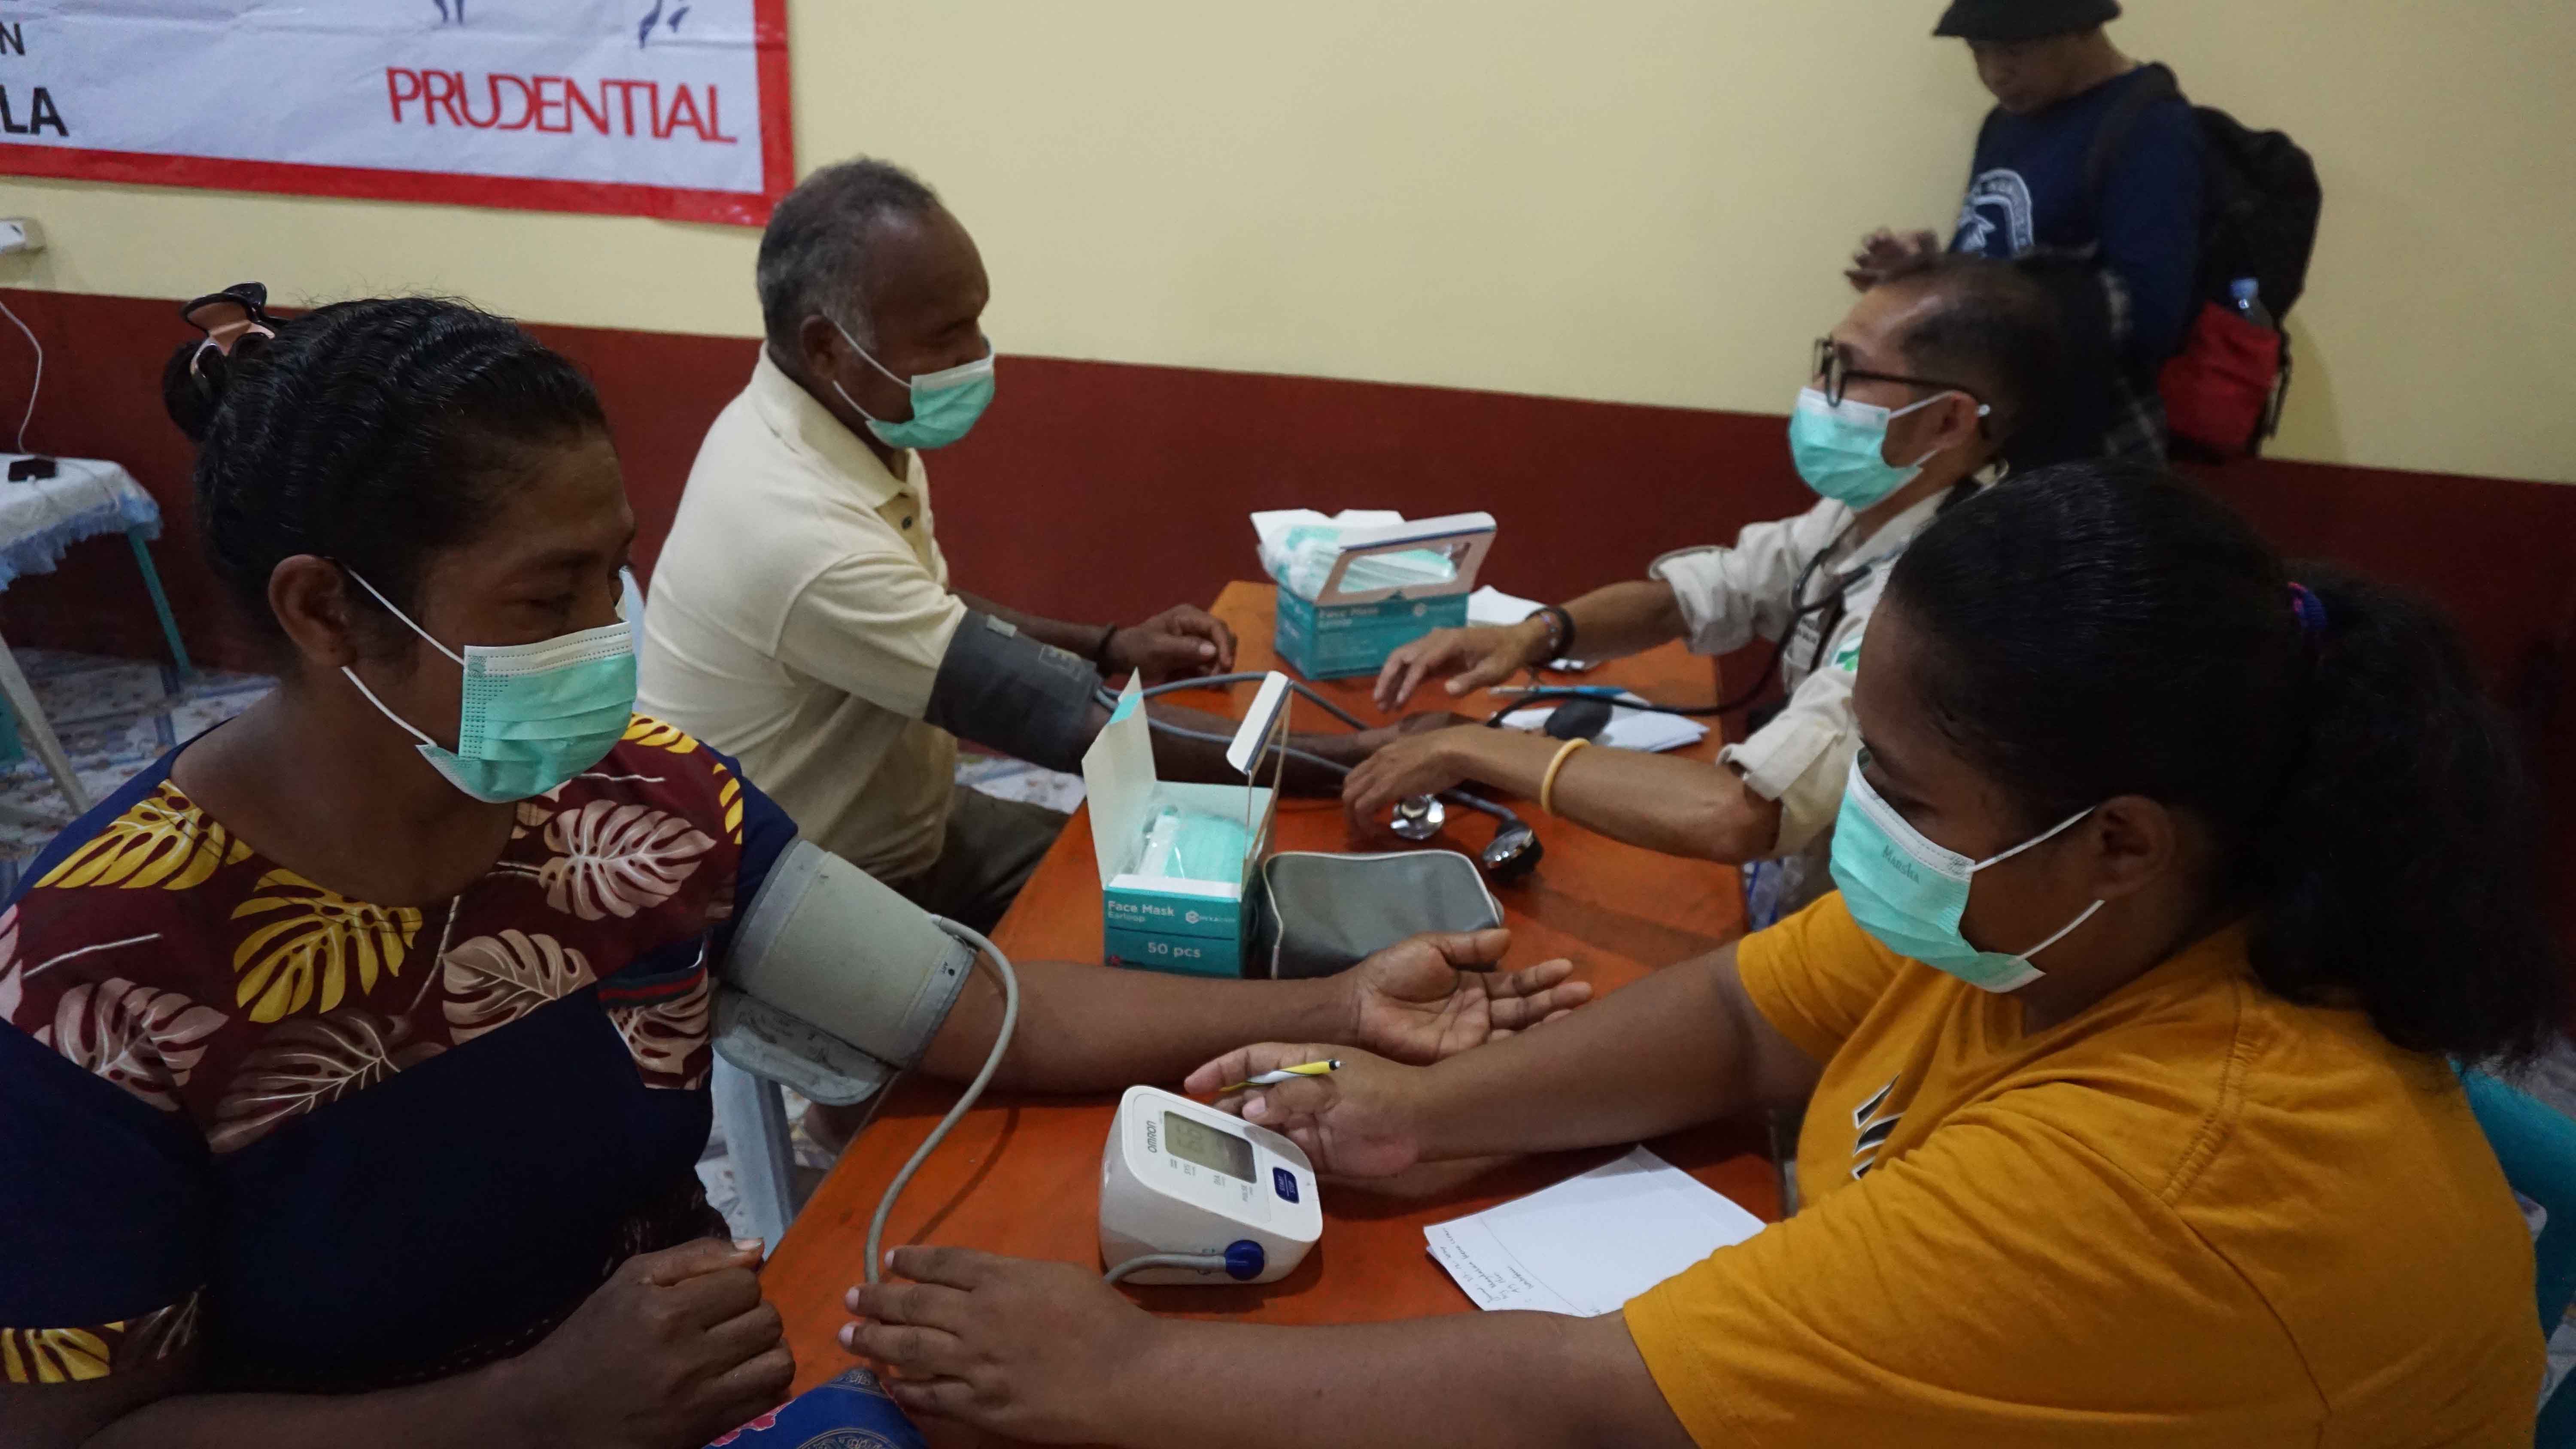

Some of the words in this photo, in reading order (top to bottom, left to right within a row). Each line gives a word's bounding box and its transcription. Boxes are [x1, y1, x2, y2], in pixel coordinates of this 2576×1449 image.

[0, 84, 69, 137] LA
[387, 67, 738, 144] PRUDENTIAL
[1108, 900, 1138, 913] Face
[1142, 903, 1175, 917] Mask
[1148, 941, 1168, 955] 50
[1173, 947, 1201, 958] pcs
[1147, 1120, 1157, 1154] OMRON
